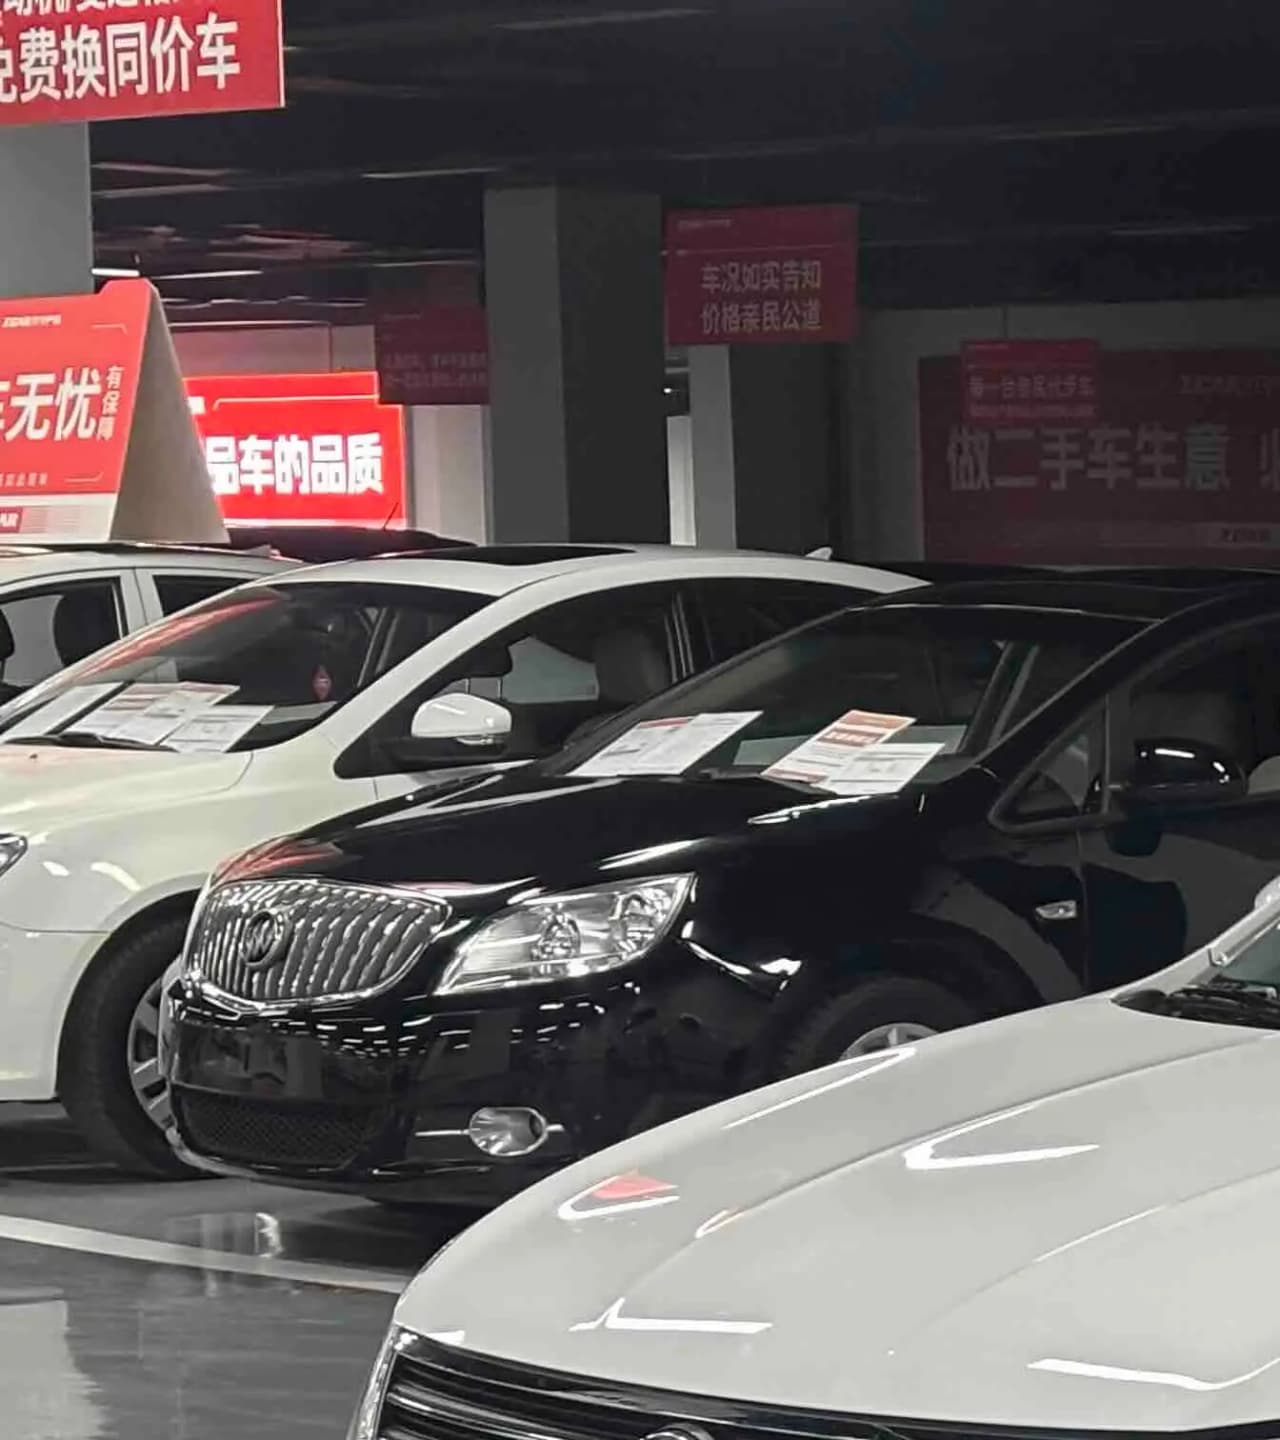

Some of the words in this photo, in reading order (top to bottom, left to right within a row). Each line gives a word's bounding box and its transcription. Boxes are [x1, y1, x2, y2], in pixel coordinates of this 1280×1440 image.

[701, 259, 821, 293] 车况如实告知
[700, 298, 822, 336] 价格亲民公道
[0, 367, 102, 442] 无忧
[97, 366, 124, 440] 有保障
[947, 423, 1232, 493] 做二手车生意
